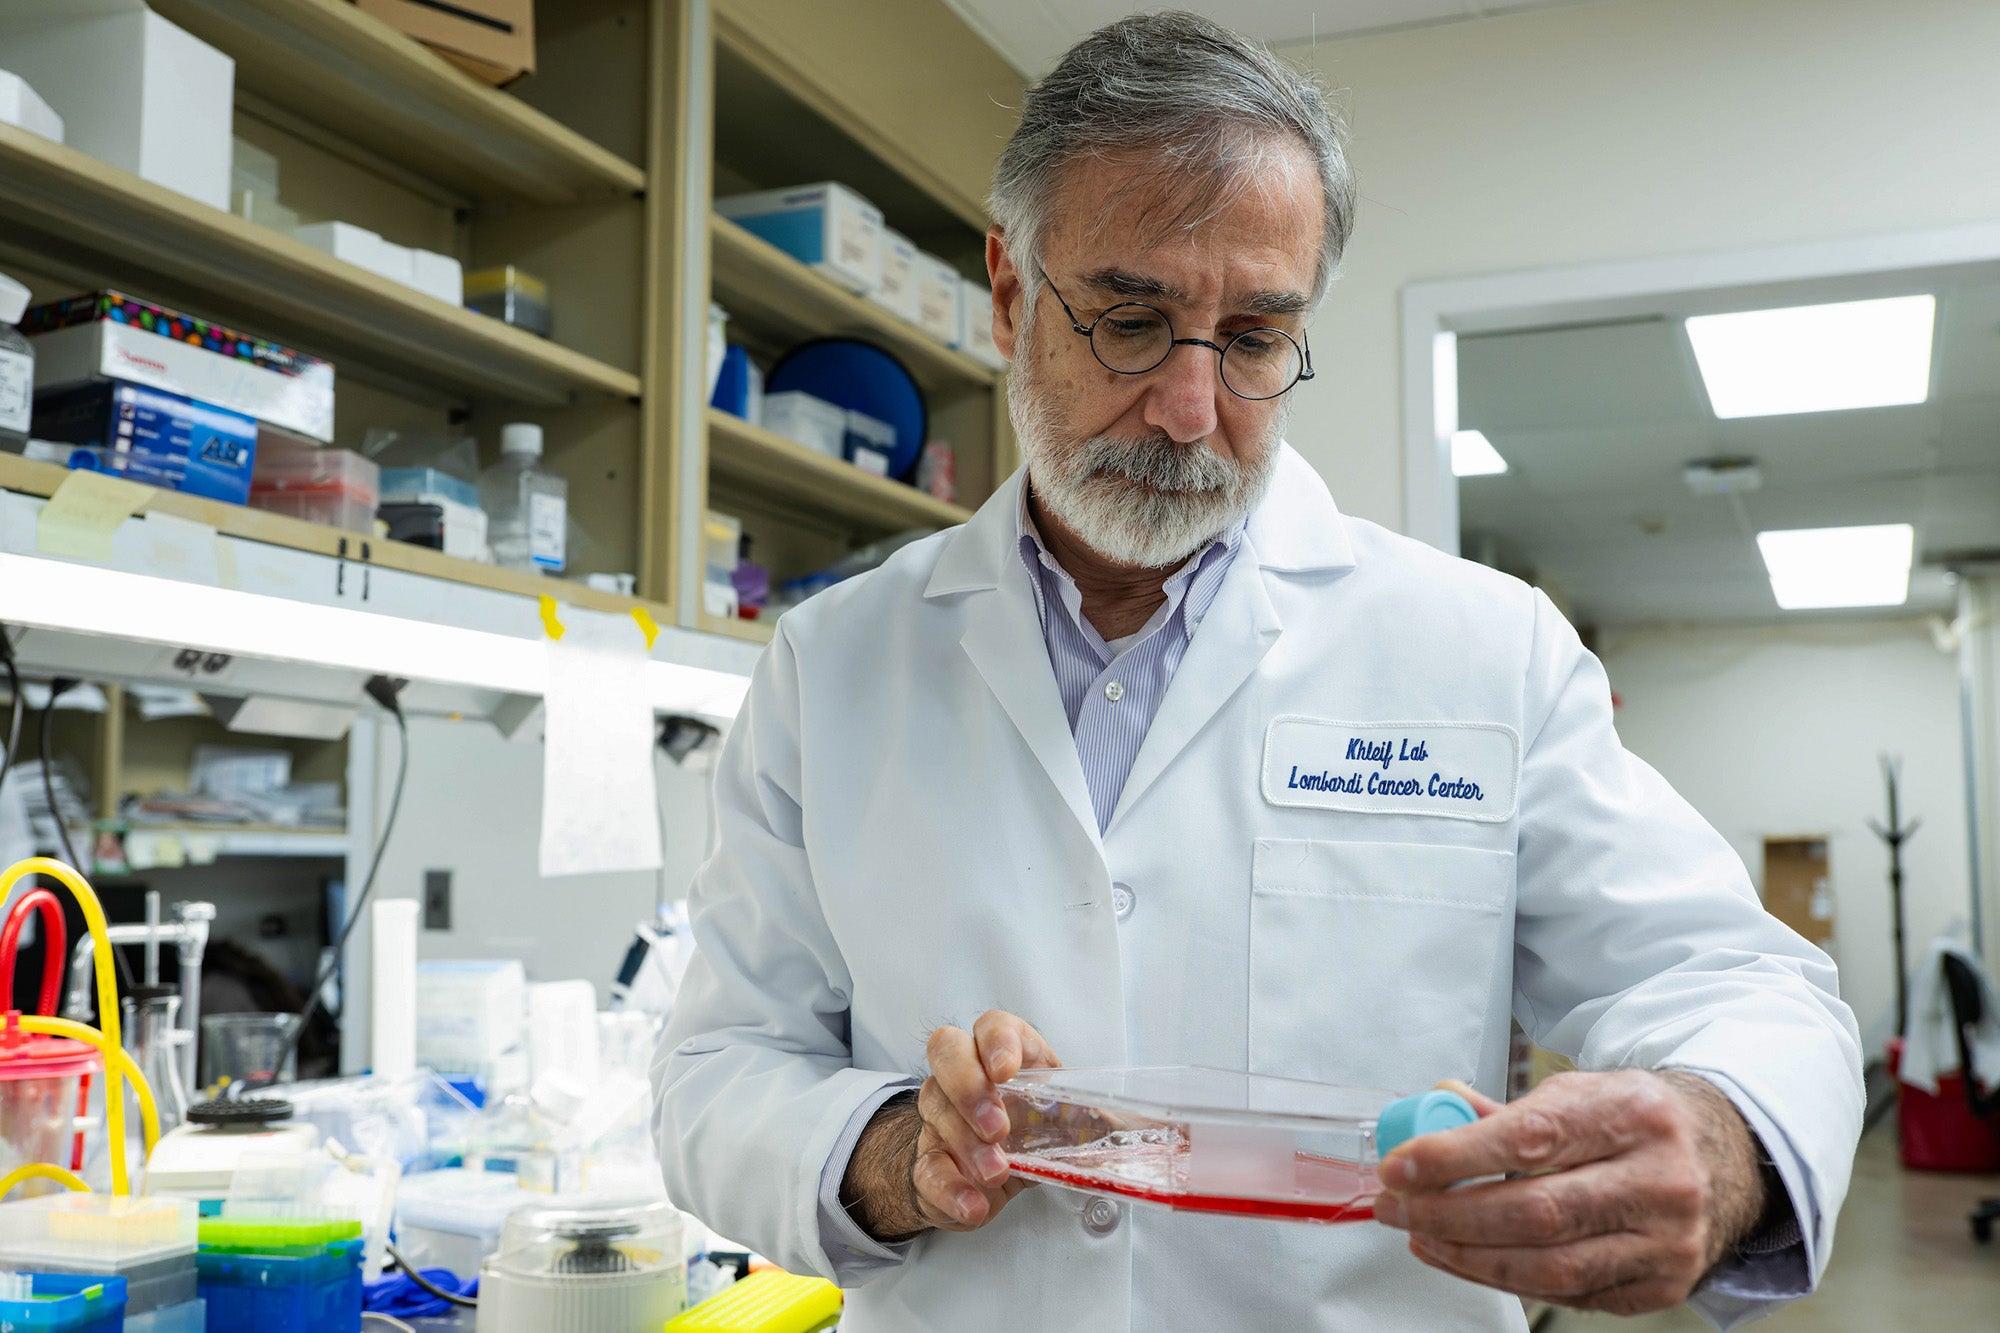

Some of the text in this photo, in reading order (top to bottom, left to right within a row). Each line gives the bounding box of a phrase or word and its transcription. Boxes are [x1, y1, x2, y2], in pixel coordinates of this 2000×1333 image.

[1345, 737, 1429, 770] Khleif Lab
[1287, 764, 1485, 801] Lombardi Cancer Center
